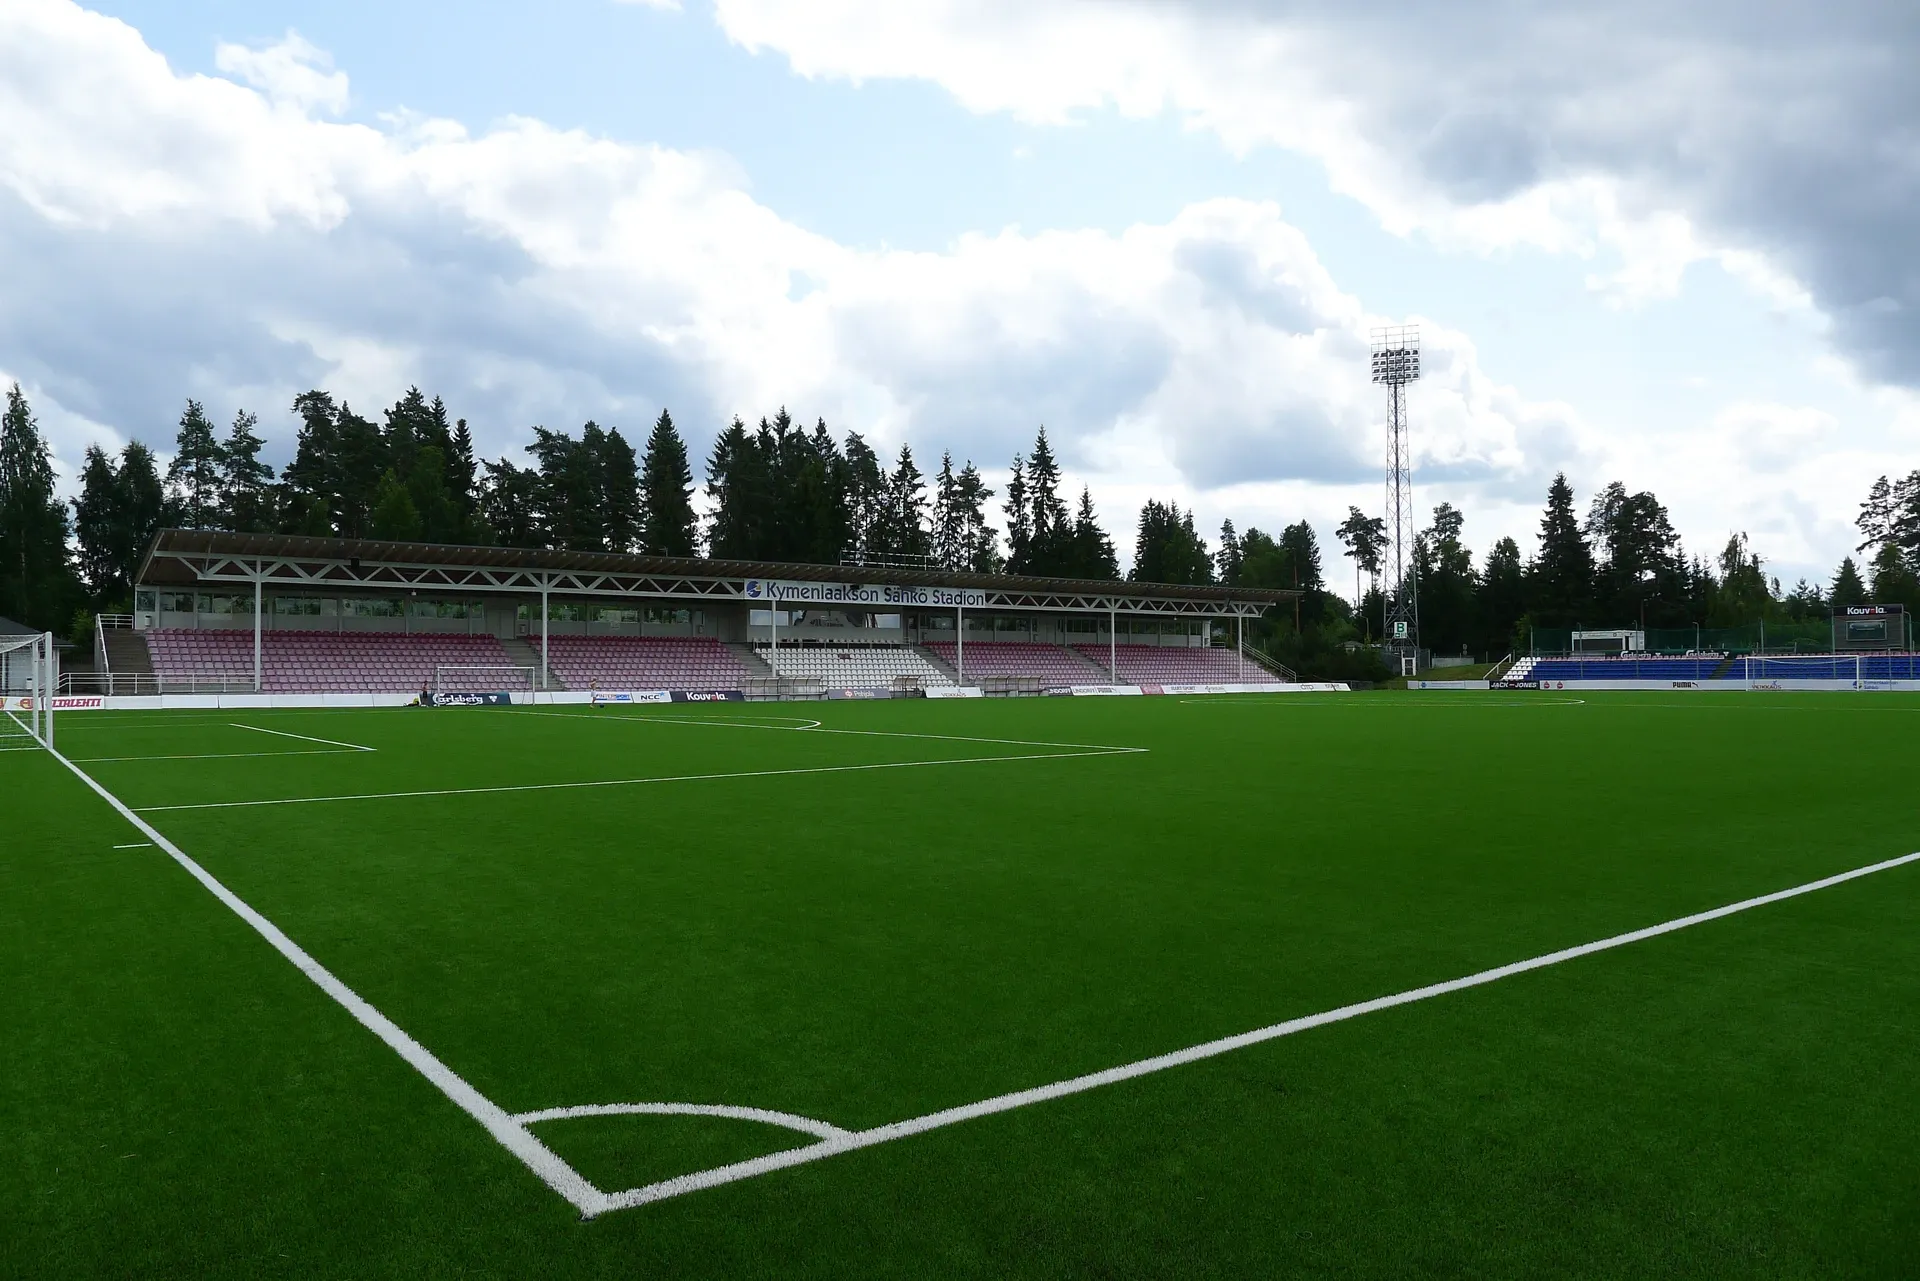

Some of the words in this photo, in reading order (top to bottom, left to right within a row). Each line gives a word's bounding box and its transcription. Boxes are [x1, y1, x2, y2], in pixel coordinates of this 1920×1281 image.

[766, 581, 879, 603] Kymenlaakson
[884, 586, 928, 604] Sähkö
[932, 590, 984, 606] Stadion
[1397, 622, 1405, 632] B
[52, 698, 101, 708] LTALEHTI
[432, 692, 483, 705] Carlsberg
